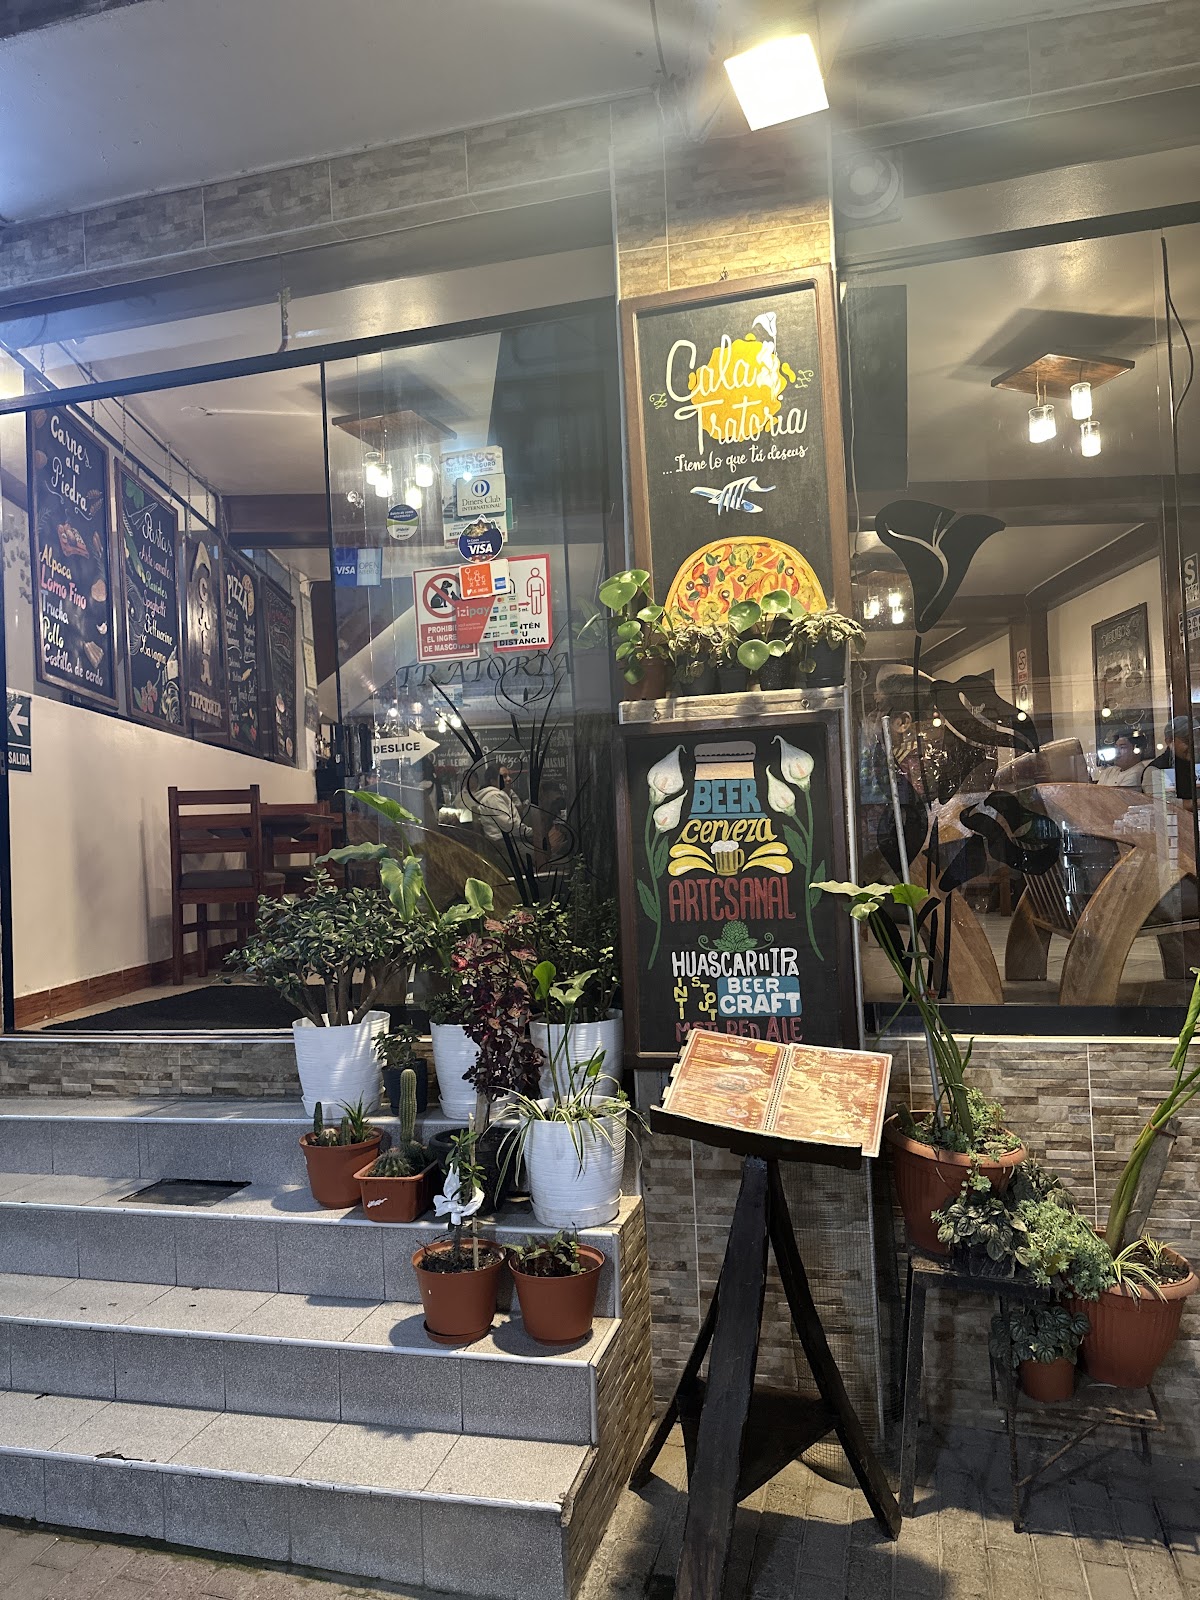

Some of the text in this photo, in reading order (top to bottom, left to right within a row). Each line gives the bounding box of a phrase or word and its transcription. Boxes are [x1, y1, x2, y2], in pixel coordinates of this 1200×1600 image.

[666, 334, 757, 401] Cala
[674, 398, 808, 455] Tratoria
[51, 415, 92, 469] Carnes
[708, 453, 723, 471] lo
[726, 456, 747, 475] que
[749, 444, 766, 462] tú
[767, 446, 808, 460] deseas
[51, 457, 88, 511] Piedra
[462, 495, 501, 507] Diners Club
[40, 544, 72, 580] Alpaca
[468, 544, 493, 555] VISA
[336, 565, 356, 575] VISA
[41, 564, 87, 610] Lomo Fino
[227, 574, 248, 621] PIZZA
[41, 590, 69, 625] Trucha
[456, 605, 490, 618] izipay
[42, 616, 65, 649] Pollo
[427, 635, 435, 643] EL
[500, 637, 546, 647] DISTANCIA
[424, 645, 433, 653] DE
[43, 644, 103, 687] Costilla de cerdo
[8, 751, 30, 767] SALIDA
[373, 742, 421, 755] DESLICE
[691, 779, 761, 814] BEER
[678, 818, 777, 844] cerveza
[668, 876, 797, 922] ARTESANAL
[672, 950, 757, 978] HUASCAR
[727, 977, 780, 993] BEER
[720, 992, 800, 1014] CRAFT
[766, 1016, 803, 1044] ALE
